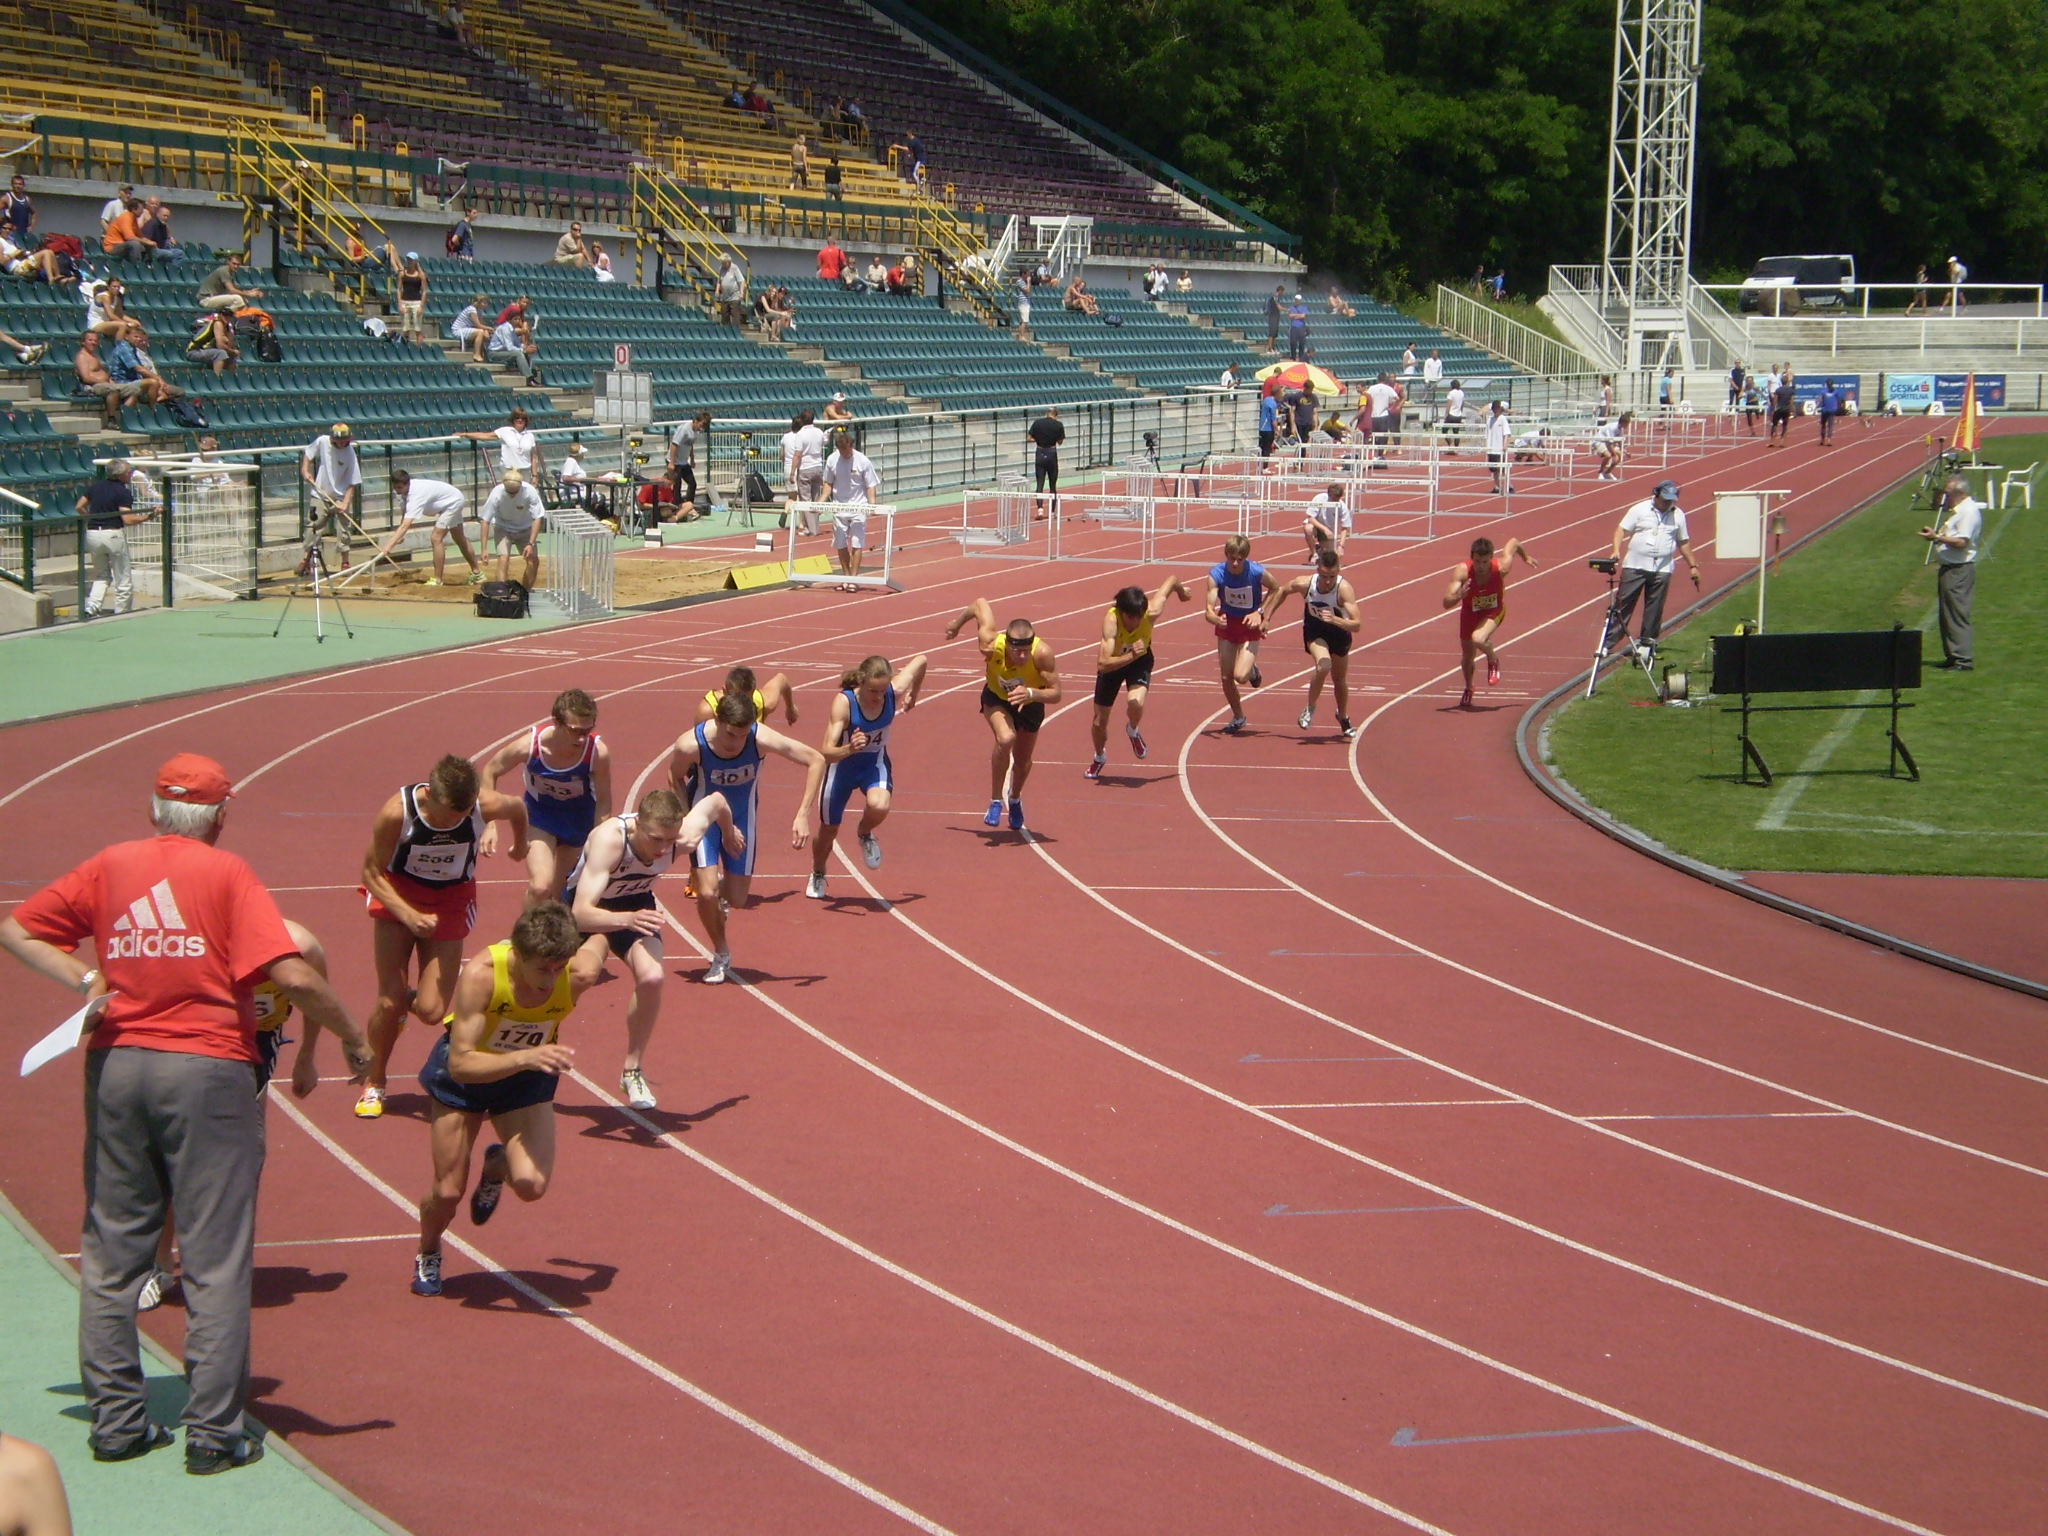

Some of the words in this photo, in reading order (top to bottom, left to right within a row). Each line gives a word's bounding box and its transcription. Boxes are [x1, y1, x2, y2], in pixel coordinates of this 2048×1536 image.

[1806, 402, 1815, 413] 5
[1934, 404, 1941, 414] 2
[809, 506, 876, 514] NORDICSPORT.COM
[106, 929, 206, 960] adidas
[499, 1029, 544, 1048] 170
